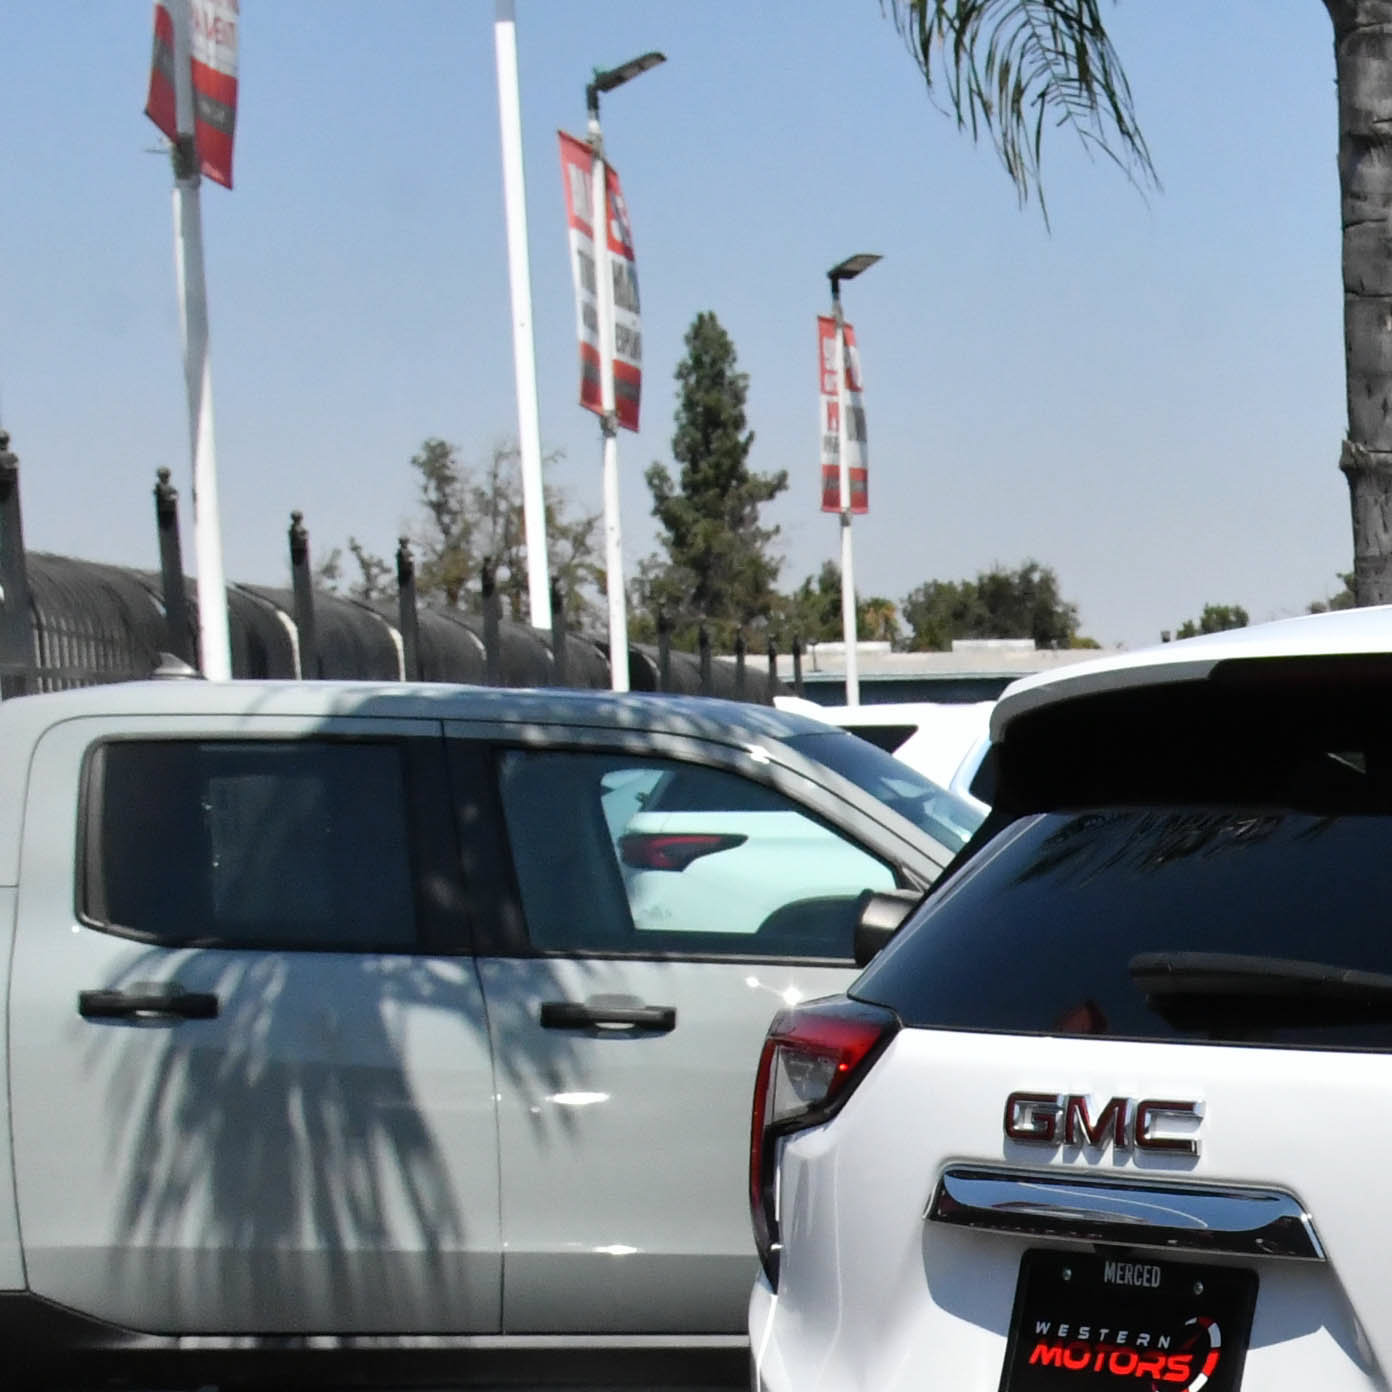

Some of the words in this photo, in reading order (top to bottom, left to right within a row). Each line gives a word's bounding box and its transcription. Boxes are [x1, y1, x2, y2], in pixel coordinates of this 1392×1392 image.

[1003, 1090, 1207, 1157] GMC
[1104, 1260, 1161, 1288] MERCED
[1035, 1320, 1171, 1349] WESTERN
[1028, 1338, 1194, 1382] MOTORS
